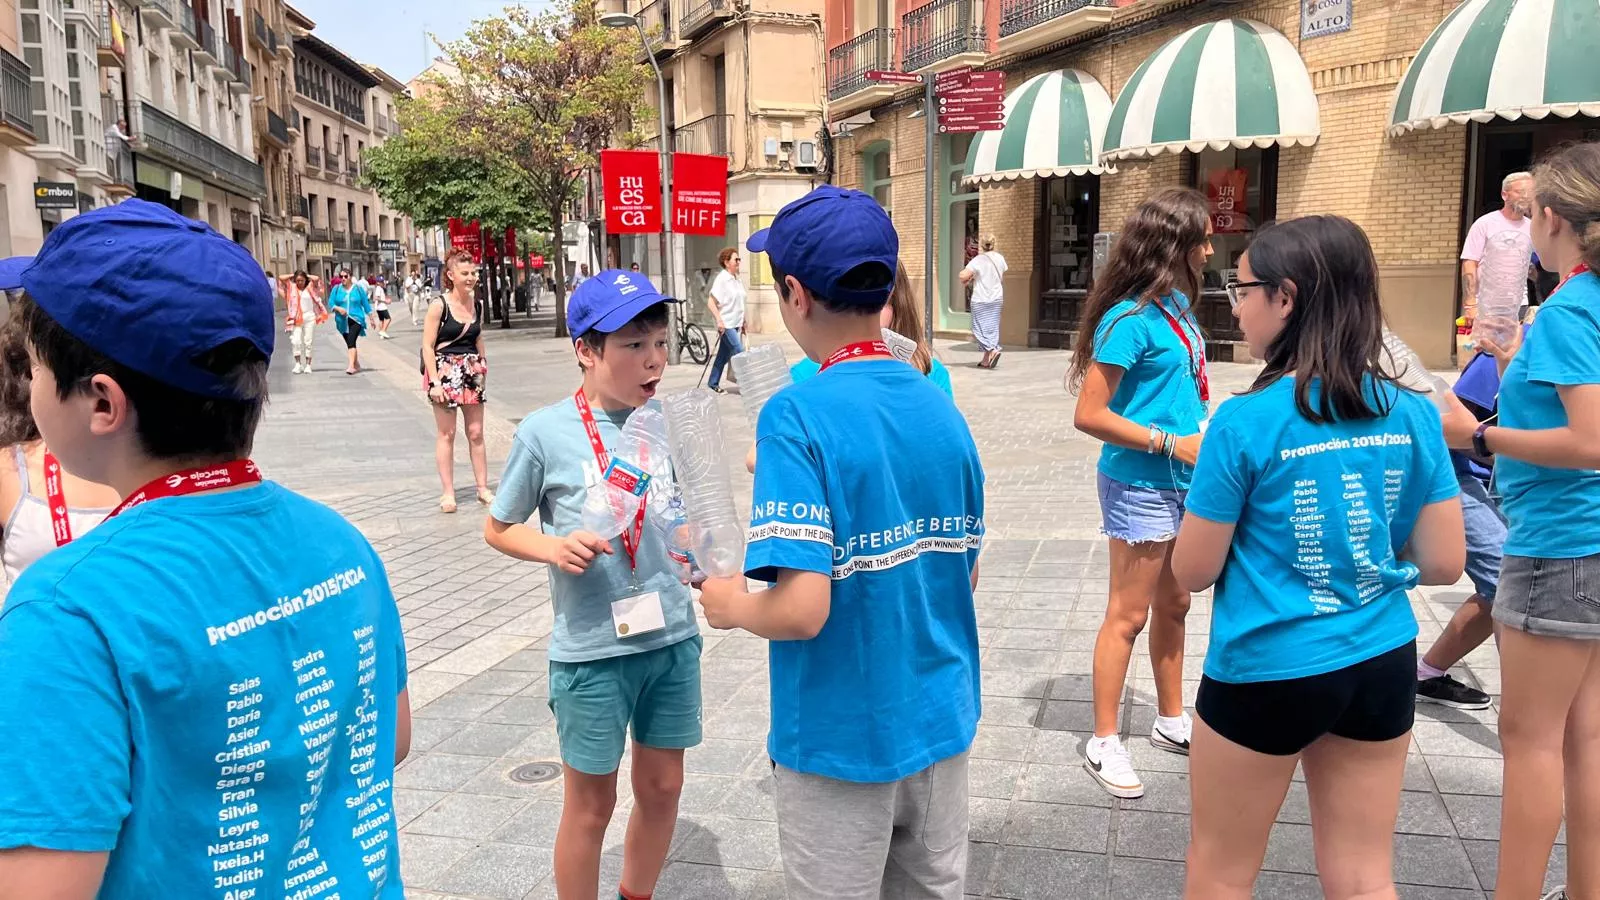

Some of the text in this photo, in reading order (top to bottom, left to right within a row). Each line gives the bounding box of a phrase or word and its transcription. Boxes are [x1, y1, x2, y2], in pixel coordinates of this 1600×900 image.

[1308, 15, 1343, 31] ALTO
[36, 187, 73, 197] embou
[677, 208, 721, 229] HIFF
[1280, 433, 1412, 461] Promoción 2015/2024
[1293, 488, 1318, 496] Pablo
[1294, 479, 1317, 488] Salas
[767, 501, 788, 518] BE
[792, 503, 830, 525] ONE
[1289, 514, 1325, 522] Cristian
[1295, 506, 1319, 514] Asier
[760, 529, 766, 538] BE
[767, 525, 779, 535] ONE
[780, 527, 801, 537] POINT
[805, 528, 817, 538] THE
[1295, 523, 1322, 531] Diego
[832, 570, 842, 578] BE
[843, 564, 854, 577] ONE
[854, 560, 874, 570] POINT
[876, 556, 890, 567] THE
[934, 541, 964, 549] WINNING
[1298, 555, 1324, 563] Leyre
[206, 565, 367, 646] Promoción 2015/2024
[1308, 595, 1342, 606] Claudia
[229, 676, 261, 695] Salas
[226, 692, 263, 712] Pablo
[303, 699, 331, 717] Lola
[226, 726, 260, 745] Asier
[214, 739, 271, 763] Cristian
[221, 759, 266, 776] Diego
[216, 772, 265, 790] Sara B
[222, 788, 255, 804] Fran
[218, 802, 259, 821] Silvia
[219, 819, 260, 838] Leyre
[352, 812, 390, 839] Adriana
[207, 833, 270, 857] Natasha
[213, 849, 265, 872] Ixeia.H
[214, 867, 264, 889] Judith
[284, 861, 328, 890] Ismael
[223, 887, 257, 900] Alex
[284, 876, 338, 900] Adriana
